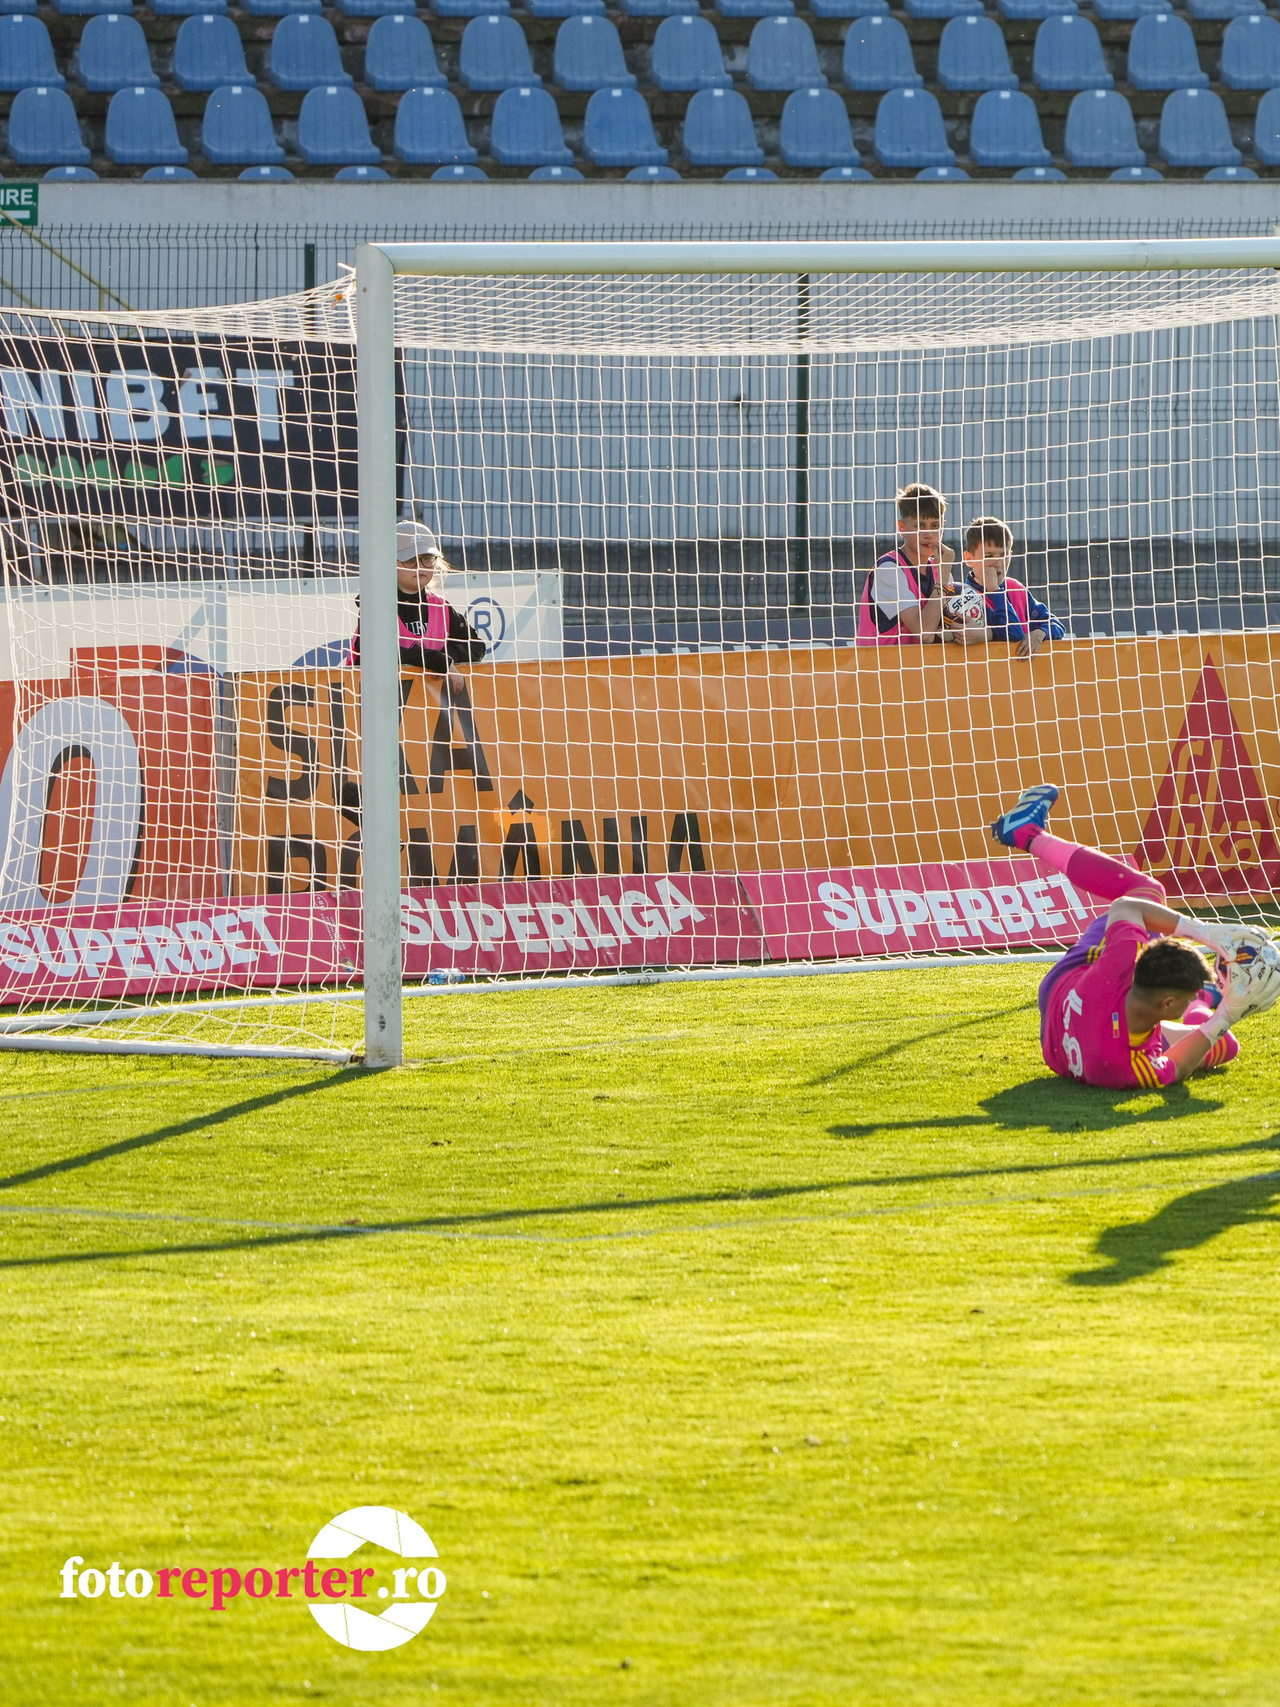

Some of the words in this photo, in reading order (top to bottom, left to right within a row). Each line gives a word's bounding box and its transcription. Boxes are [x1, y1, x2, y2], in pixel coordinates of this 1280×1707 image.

[266, 678, 494, 801] SIA
[0, 905, 280, 978] SUPERBET
[400, 877, 707, 953] SUPERLIGA
[817, 872, 1089, 938] SUPERBET
